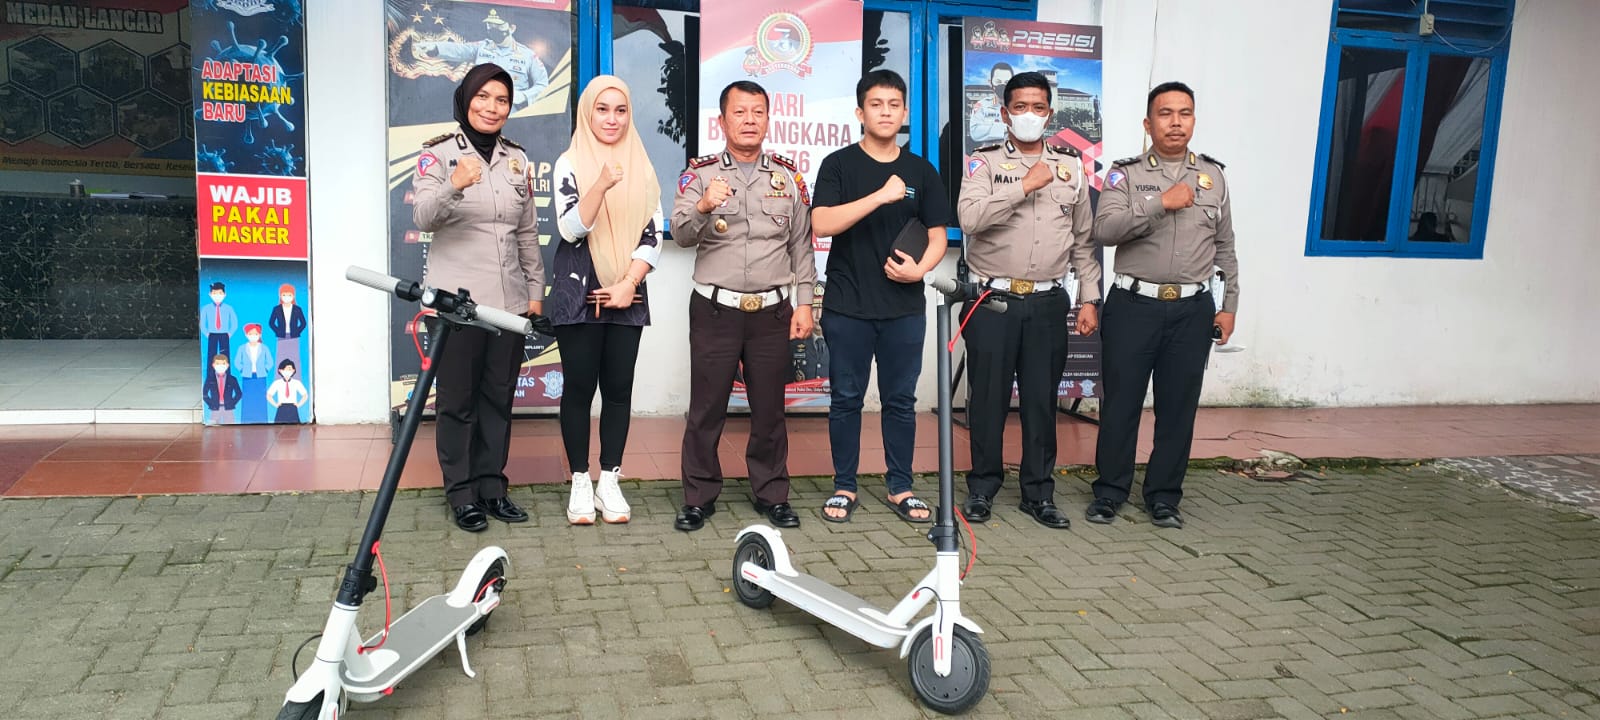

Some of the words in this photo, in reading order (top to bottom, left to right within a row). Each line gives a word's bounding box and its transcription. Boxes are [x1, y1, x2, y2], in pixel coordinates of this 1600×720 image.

[5, 2, 78, 28] MEDAN
[83, 7, 163, 34] LANCAR
[1012, 30, 1096, 48] PRESISI
[202, 60, 277, 83] ADAPTASI
[202, 81, 291, 104] KEBIASAAN
[202, 101, 246, 122] BARU
[209, 184, 292, 206] WAJIB
[212, 205, 290, 225] PAKAI
[212, 225, 290, 245] MASKER
